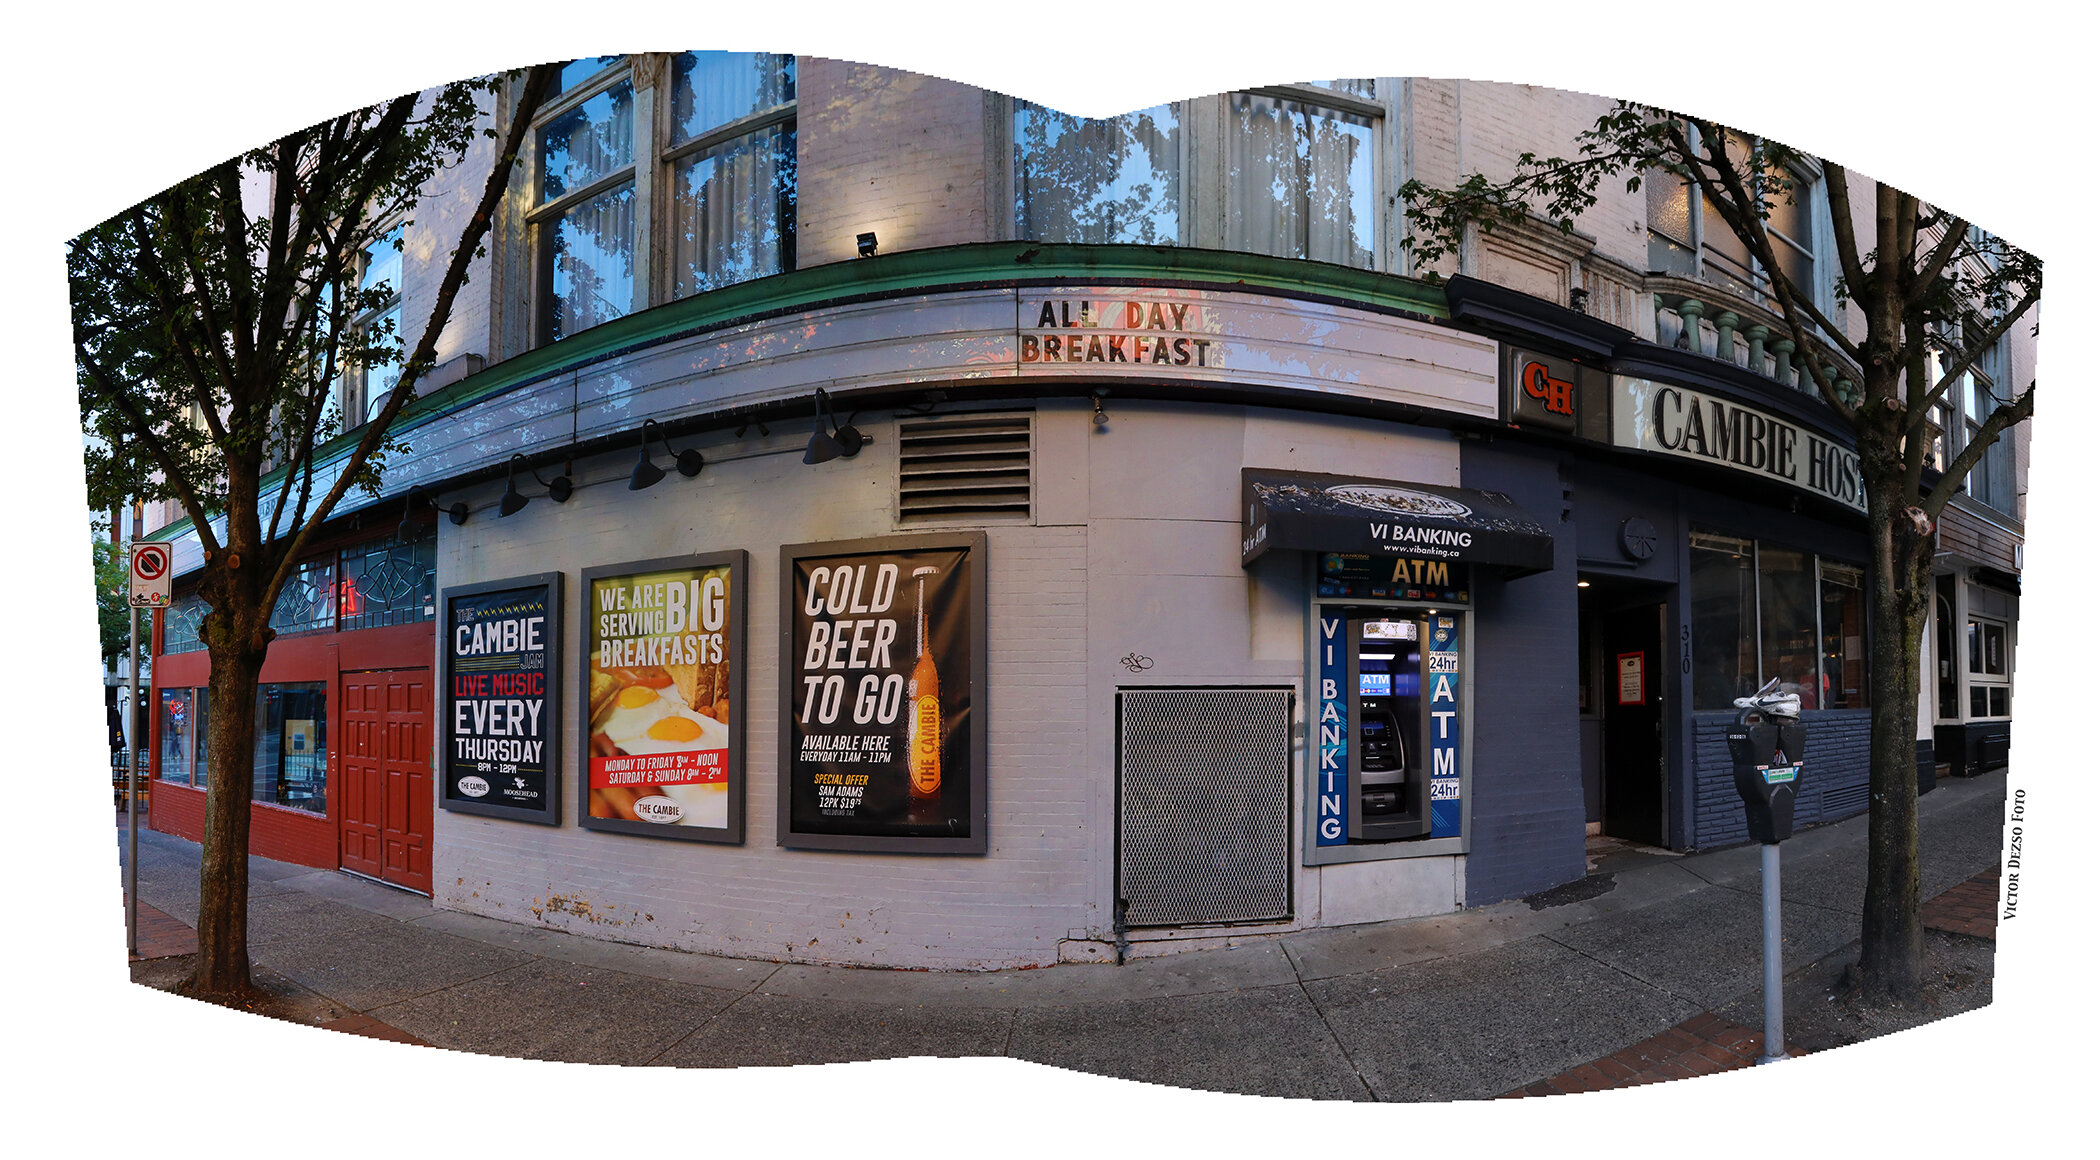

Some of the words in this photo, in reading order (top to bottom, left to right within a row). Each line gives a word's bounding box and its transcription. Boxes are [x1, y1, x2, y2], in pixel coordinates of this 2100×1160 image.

[1038, 300, 1099, 328] ALL
[1127, 301, 1190, 332] DAY
[1021, 334, 1211, 367] BREAKFAST
[1522, 361, 1574, 417] CH
[1653, 387, 1797, 482] CAMBIE
[1370, 523, 1388, 539] VI
[1392, 525, 1472, 548] BANKING
[1383, 544, 1460, 558] www.vibanking.ca
[1391, 558, 1449, 587] ATM
[600, 587, 626, 611] WE
[632, 583, 664, 609] ARE
[804, 563, 899, 617] COLD
[456, 608, 475, 622] THE
[666, 577, 724, 634] BIG
[456, 617, 544, 656] CAMBIE
[600, 610, 664, 638] SERVING
[600, 633, 723, 668] BREAKFASTS
[803, 619, 898, 670] BEER
[1320, 618, 1339, 666] VI
[1681, 624, 1690, 674] 310
[520, 653, 544, 669] JAM
[1430, 656, 1456, 669] 24hr
[455, 675, 489, 697] LIVE
[493, 672, 544, 696] MUSIC
[1362, 674, 1389, 685] ATM
[801, 675, 846, 725] TO
[853, 673, 904, 725] GO
[455, 700, 543, 736] EVERY
[921, 704, 936, 755] CAMBIE
[1431, 674, 1456, 776] ATM
[456, 738, 543, 764] THURSDAY
[801, 735, 860, 751] AVAILABLE
[861, 735, 891, 751] HERE
[477, 762, 492, 772] 8PM
[499, 764, 517, 774] 12PM
[605, 759, 635, 772] MONDAY
[636, 757, 646, 770] TO
[647, 756, 675, 770] FRIDAY
[696, 753, 719, 766] NOON
[800, 750, 838, 762] EVERYDAY
[838, 752, 862, 763] 11AM
[868, 752, 892, 763] 11PM
[1320, 678, 1342, 840] BANKING
[609, 771, 646, 784] SATURDAY
[647, 771, 653, 783] &
[655, 769, 685, 782] SUNDAY
[686, 768, 699, 780] 8AM
[708, 767, 721, 780] 2PM
[814, 773, 843, 785] SPECIAL
[845, 774, 869, 786] OFFER
[920, 760, 935, 784] THE
[503, 789, 538, 798] MOOSEHEAD
[818, 785, 836, 796] SAM
[836, 786, 864, 798] ADAMS
[819, 797, 839, 808] 12PK
[1431, 783, 1458, 796] 24hr
[639, 803, 651, 814] THE
[652, 804, 680, 816] CAMBIE
